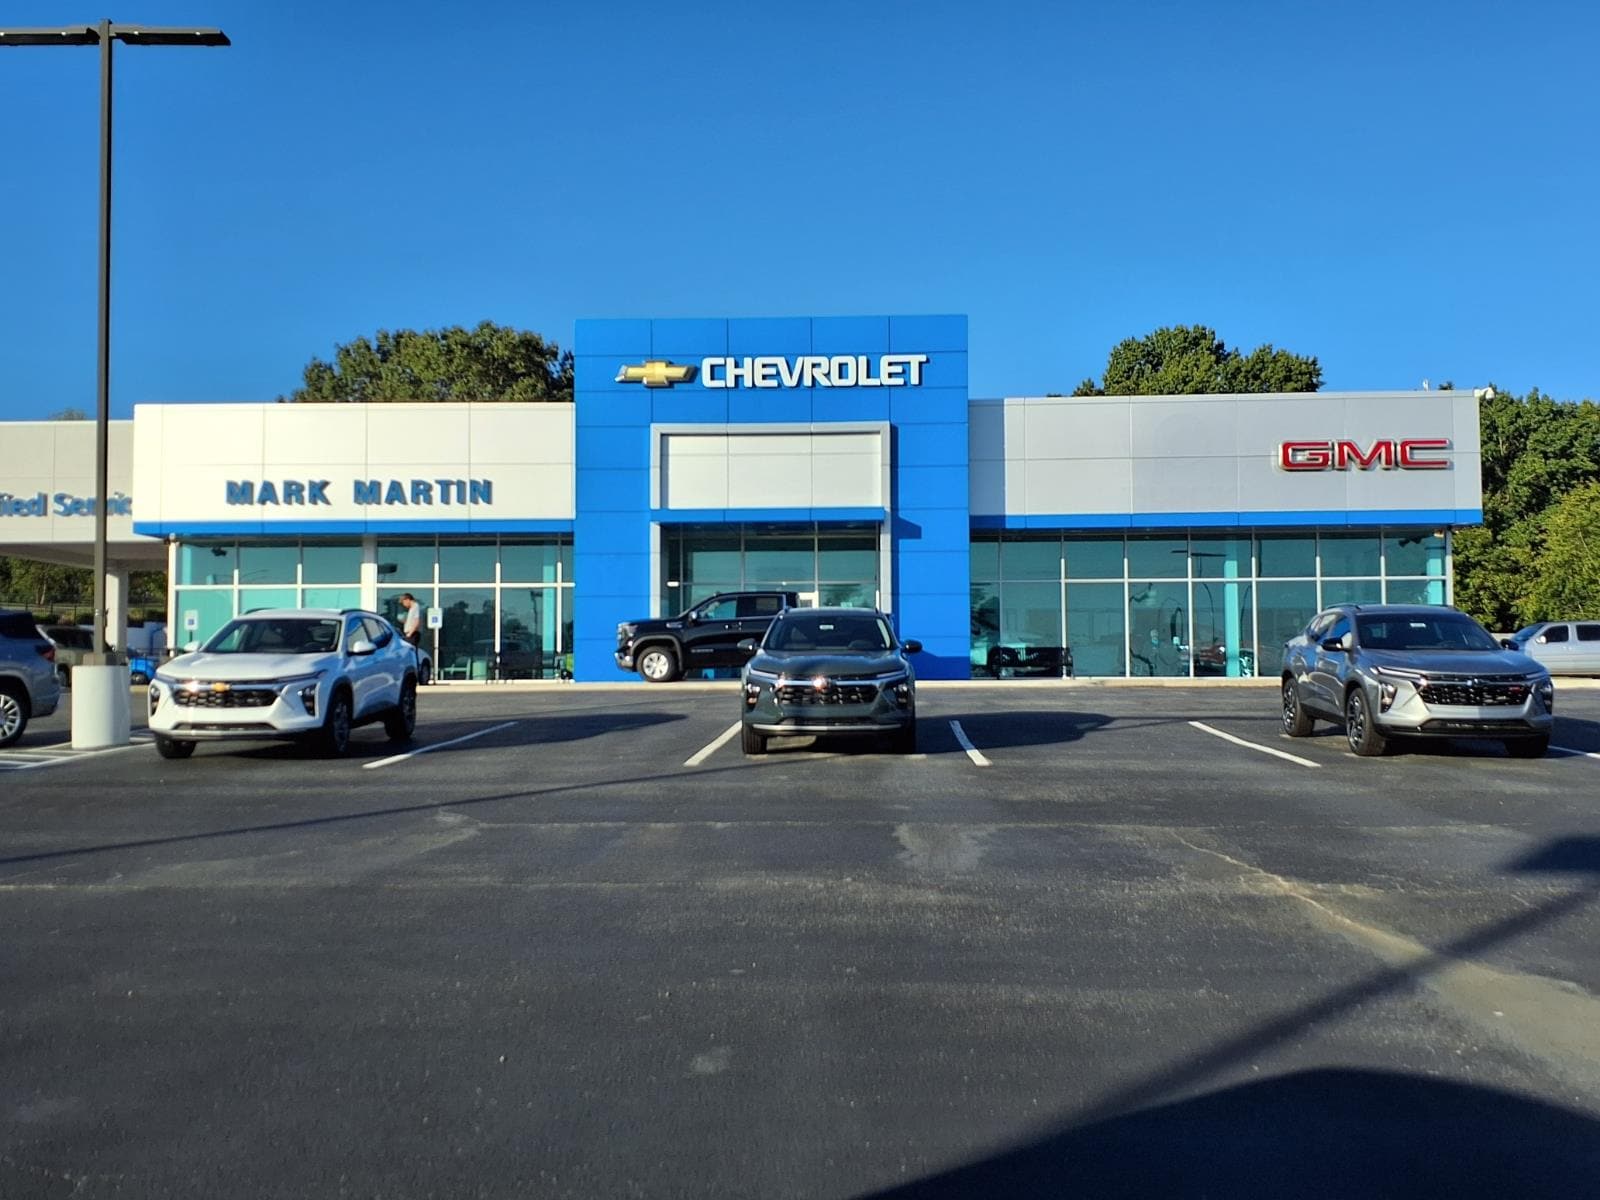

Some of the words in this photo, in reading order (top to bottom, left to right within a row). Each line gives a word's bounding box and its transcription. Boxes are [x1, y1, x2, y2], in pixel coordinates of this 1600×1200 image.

[701, 354, 928, 388] CHEVROLET
[1279, 438, 1451, 471] GMC
[225, 480, 332, 506] MARK
[353, 480, 493, 506] MARTIN
